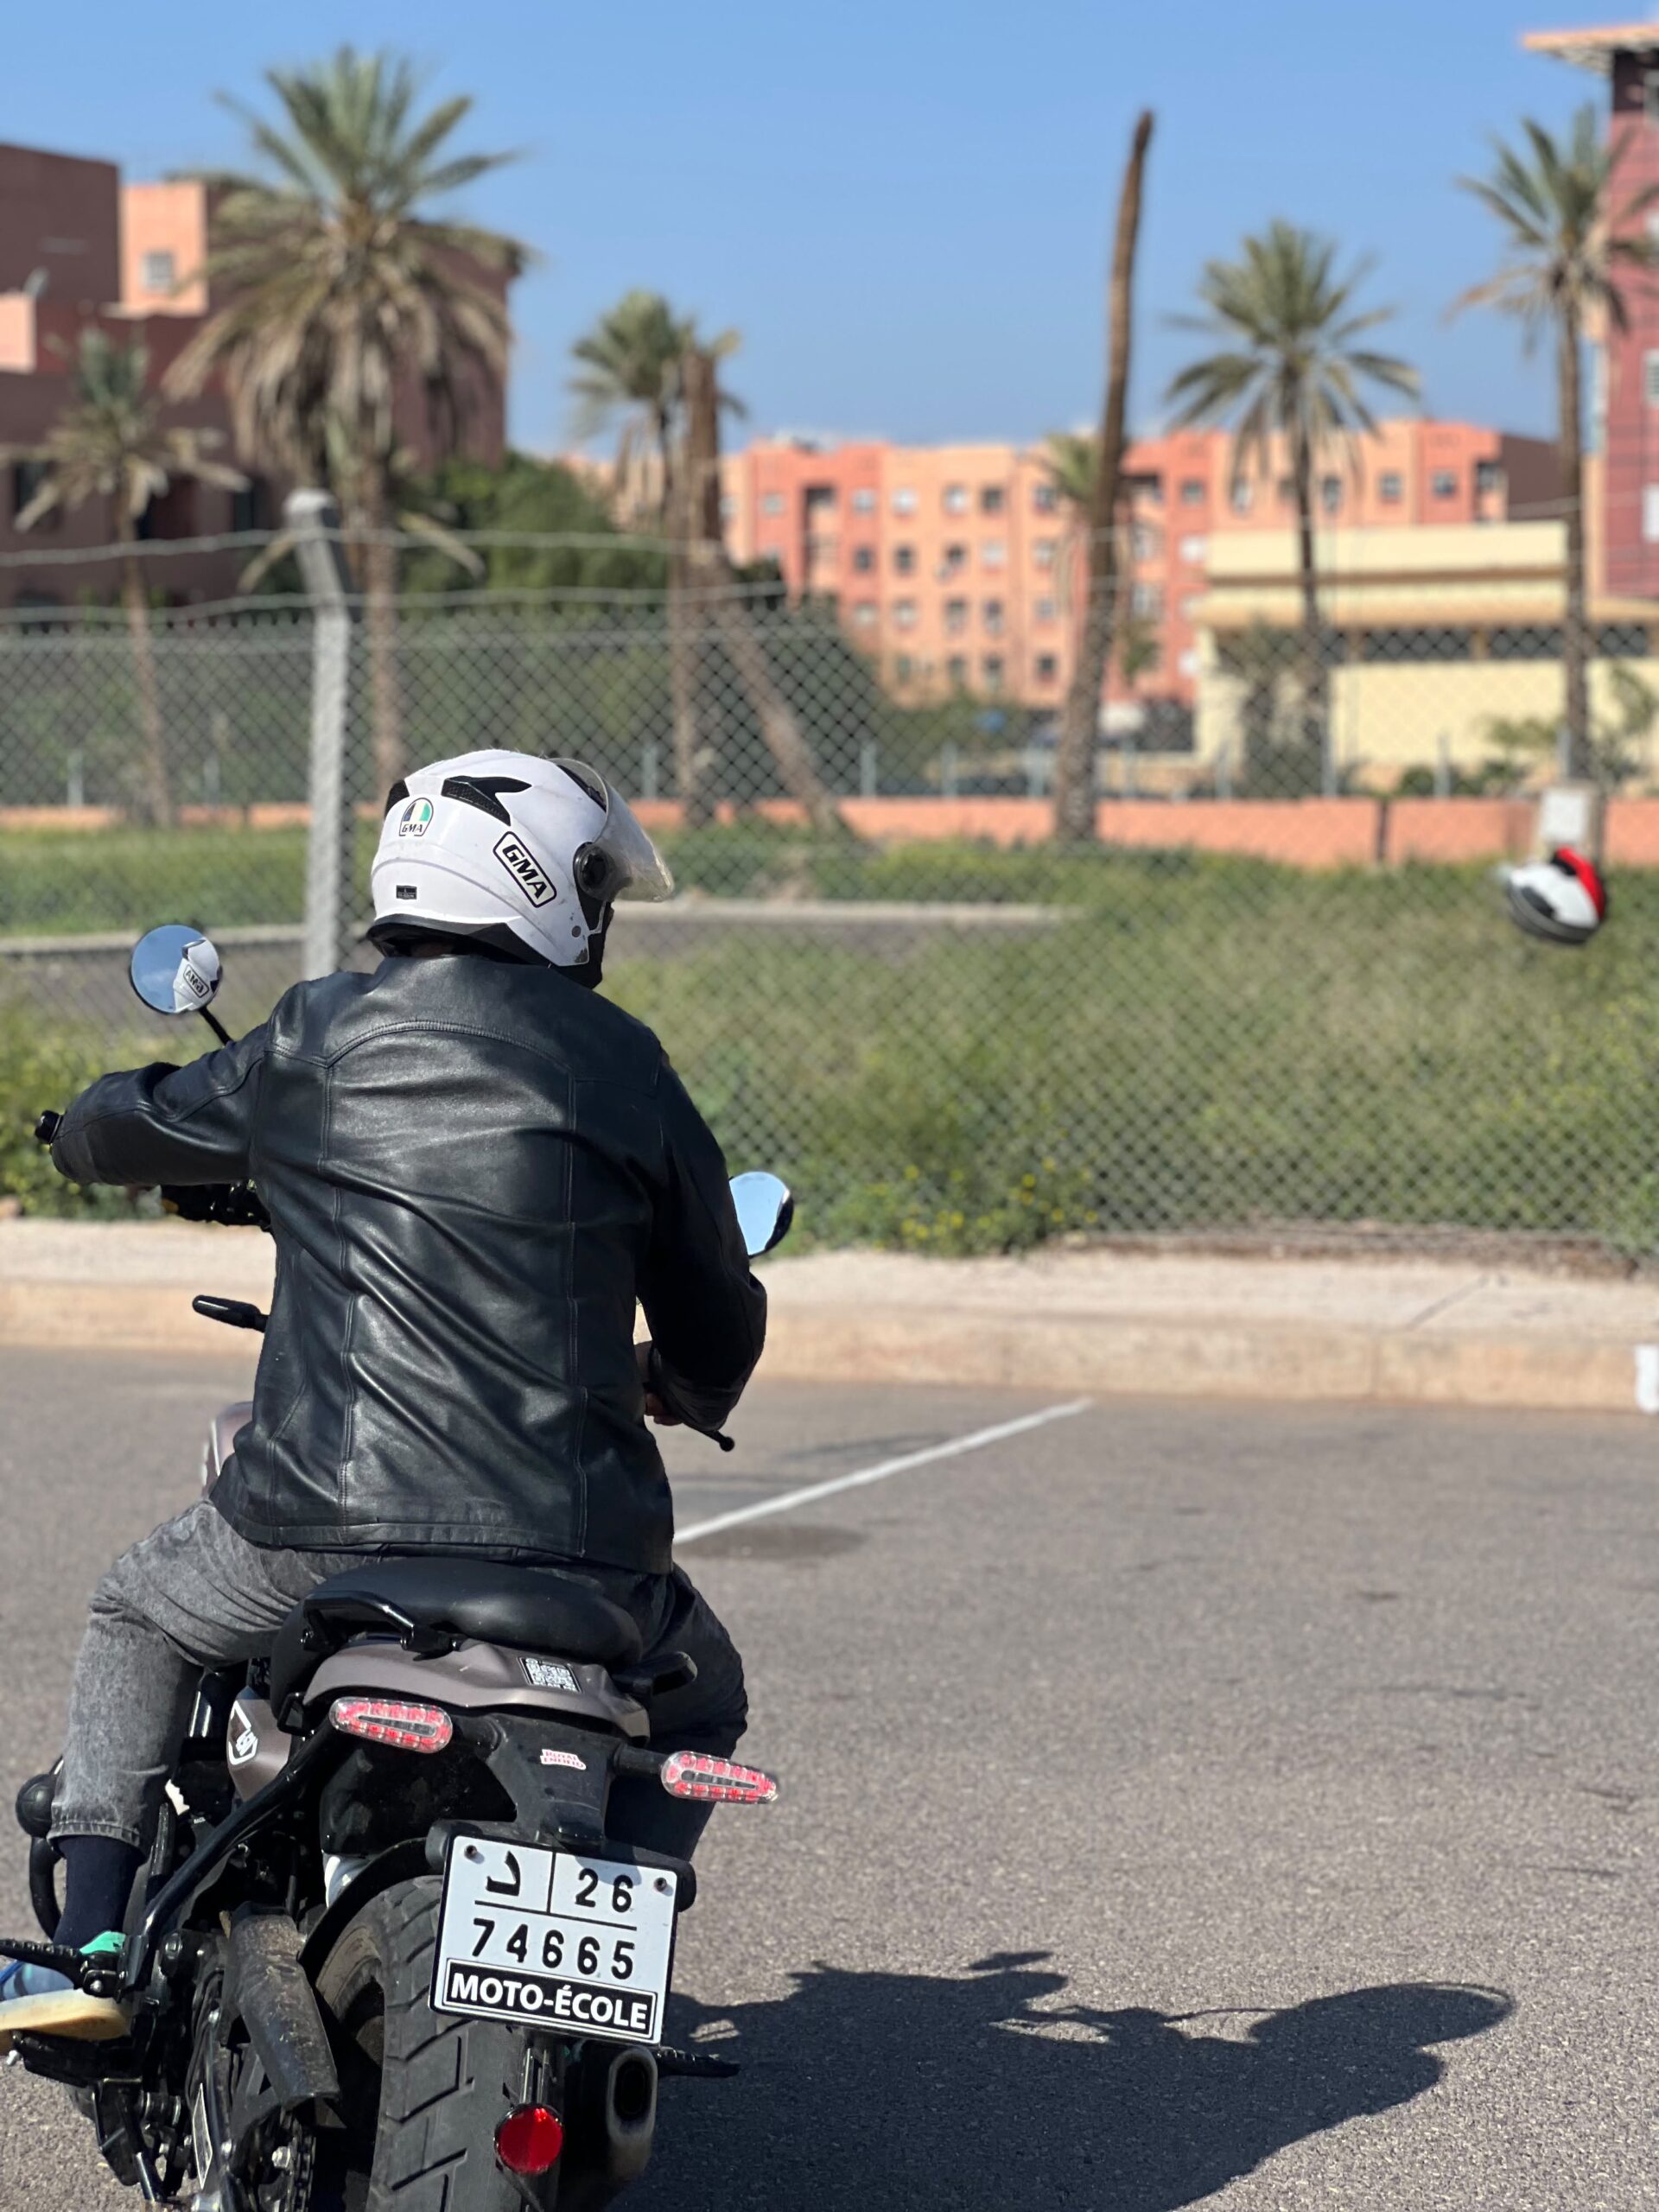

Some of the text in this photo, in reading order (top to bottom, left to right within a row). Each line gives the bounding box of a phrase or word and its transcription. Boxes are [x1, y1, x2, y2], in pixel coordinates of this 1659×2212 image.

[402, 823, 423, 833] GMA
[502, 843, 547, 899] GMA
[485, 1850, 521, 1897] د
[575, 1867, 633, 1913] 26
[472, 1917, 635, 1980] 74665
[450, 1972, 648, 2031] MOTO-ÉCOLE
